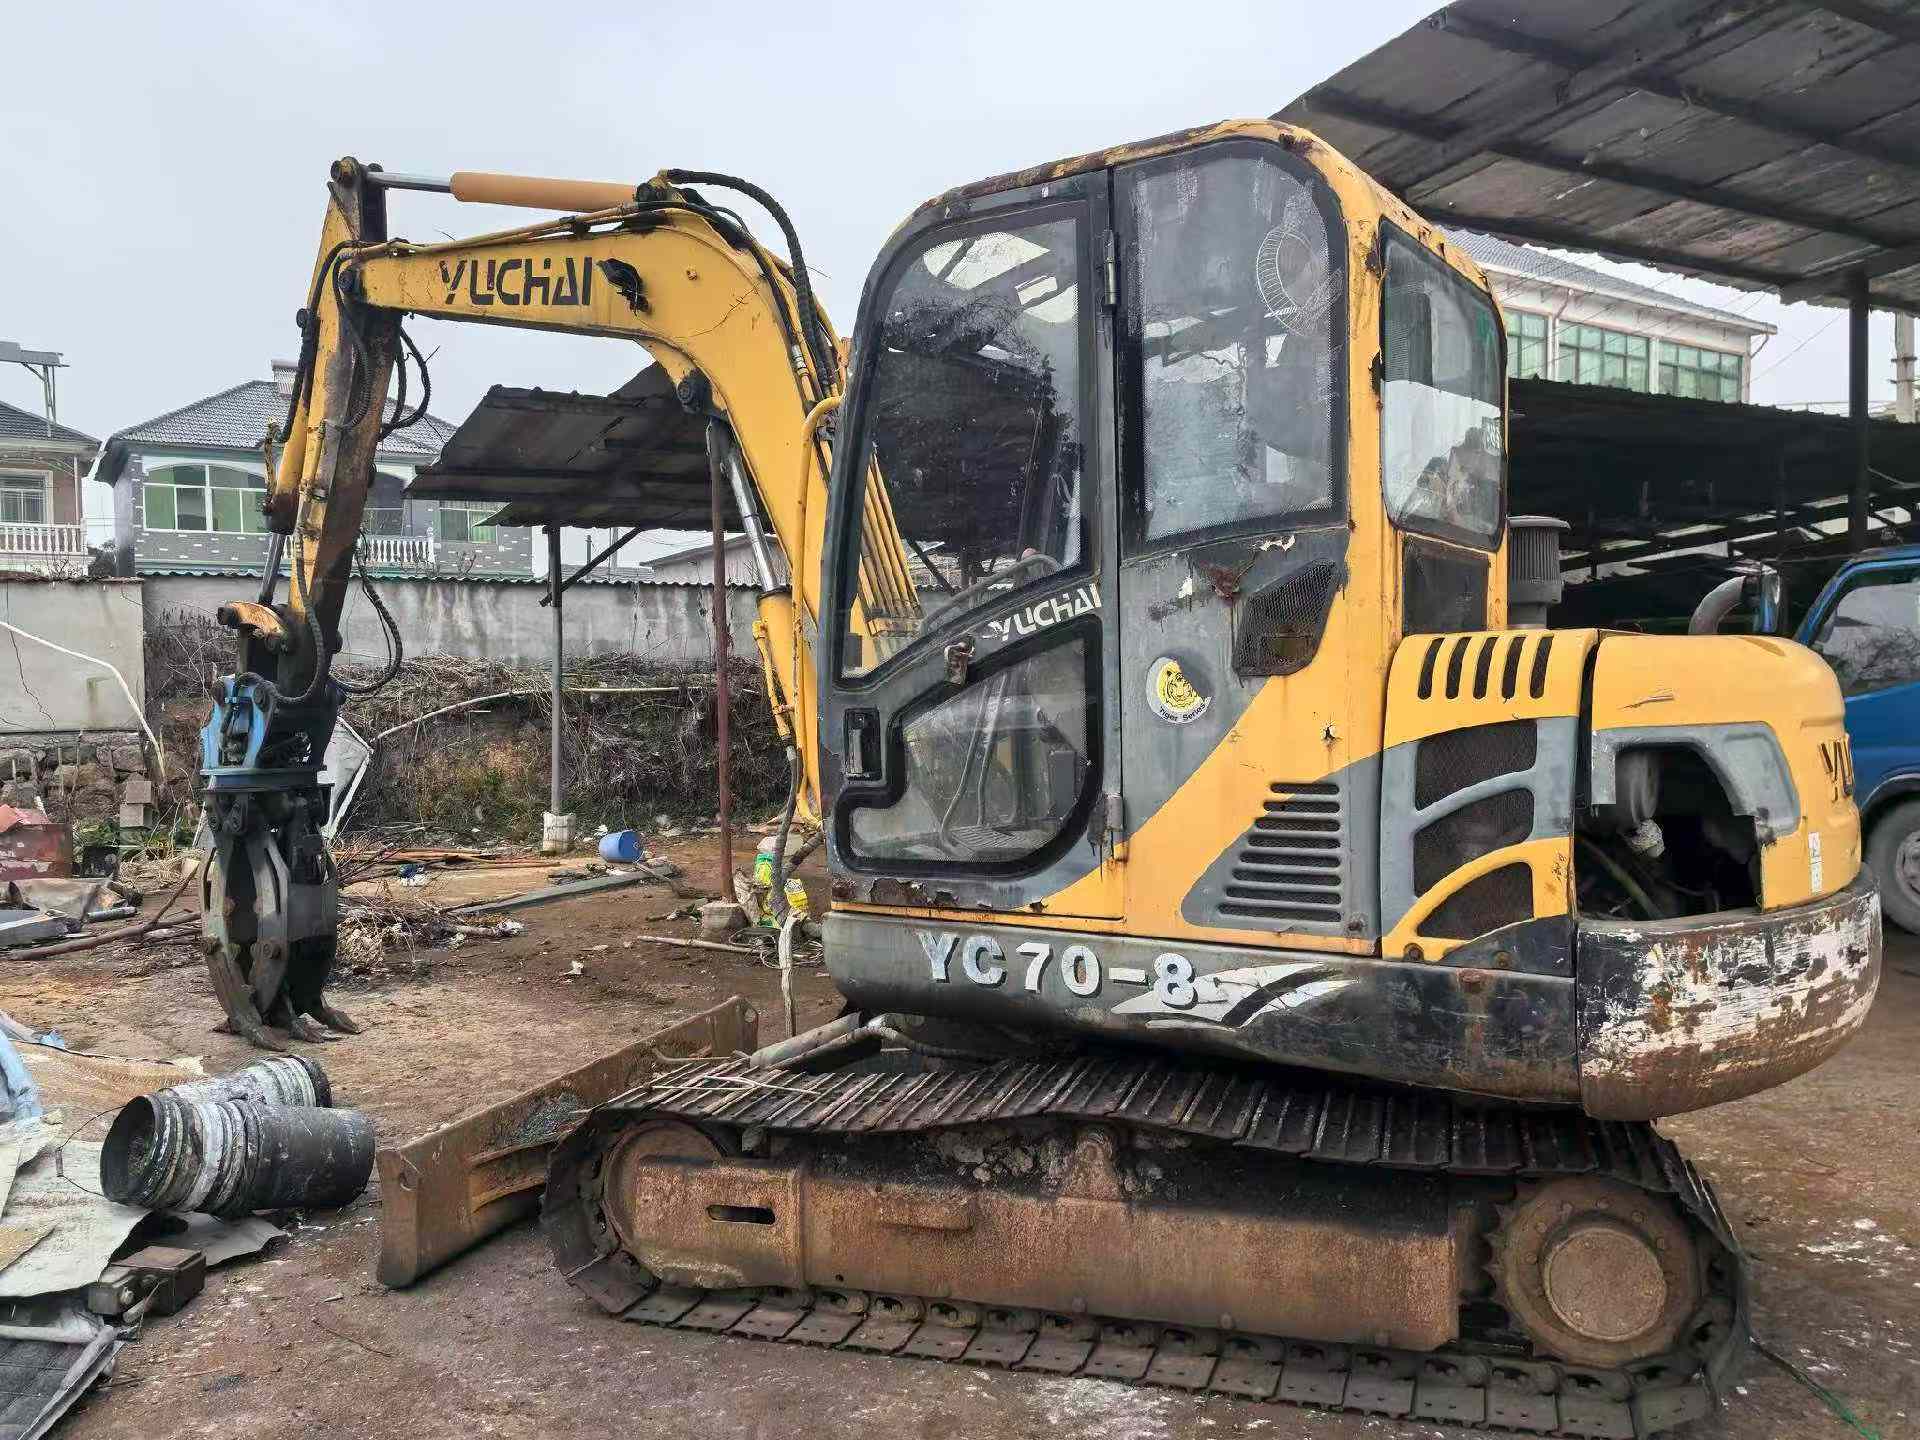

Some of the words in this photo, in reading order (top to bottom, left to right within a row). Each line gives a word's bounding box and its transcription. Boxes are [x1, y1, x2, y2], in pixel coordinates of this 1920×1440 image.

[439, 257, 593, 306] YUCHAI
[988, 583, 1102, 642] YUCHAI
[1160, 706, 1178, 721] Tiger
[1183, 703, 1206, 721] Series
